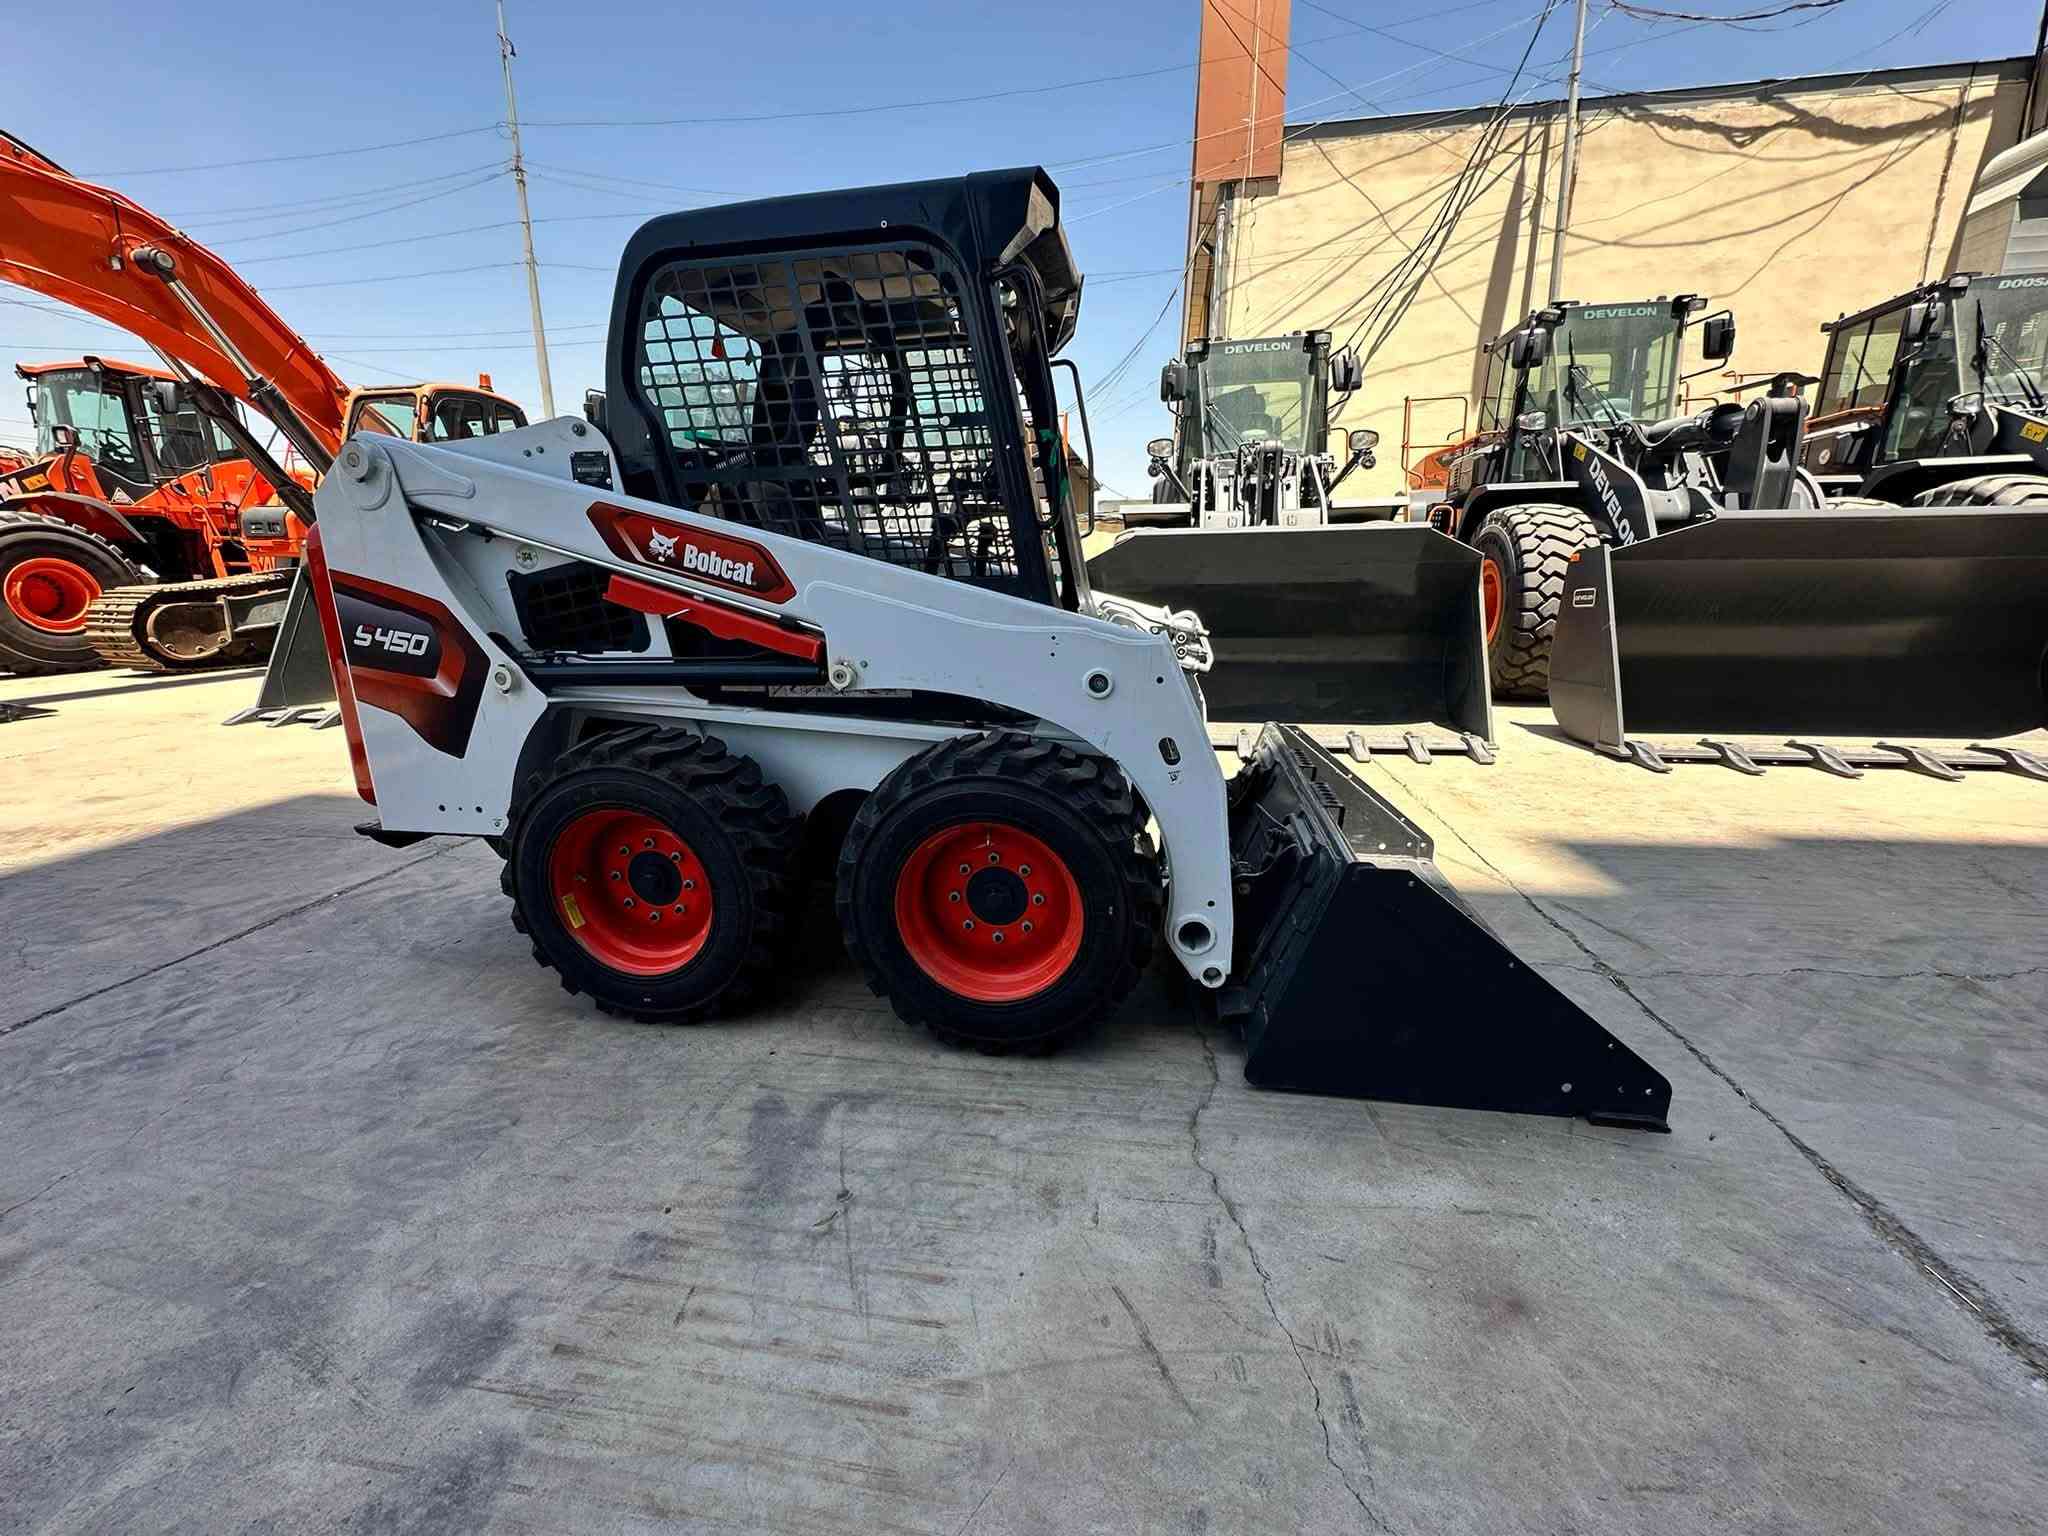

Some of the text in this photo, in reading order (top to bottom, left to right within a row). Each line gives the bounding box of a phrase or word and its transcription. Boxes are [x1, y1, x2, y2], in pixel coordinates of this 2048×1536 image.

[1583, 307, 1657, 320] DEVELON
[1224, 342, 1291, 354] DEVELON
[683, 543, 754, 585] Bobcat
[353, 624, 430, 656] S450
